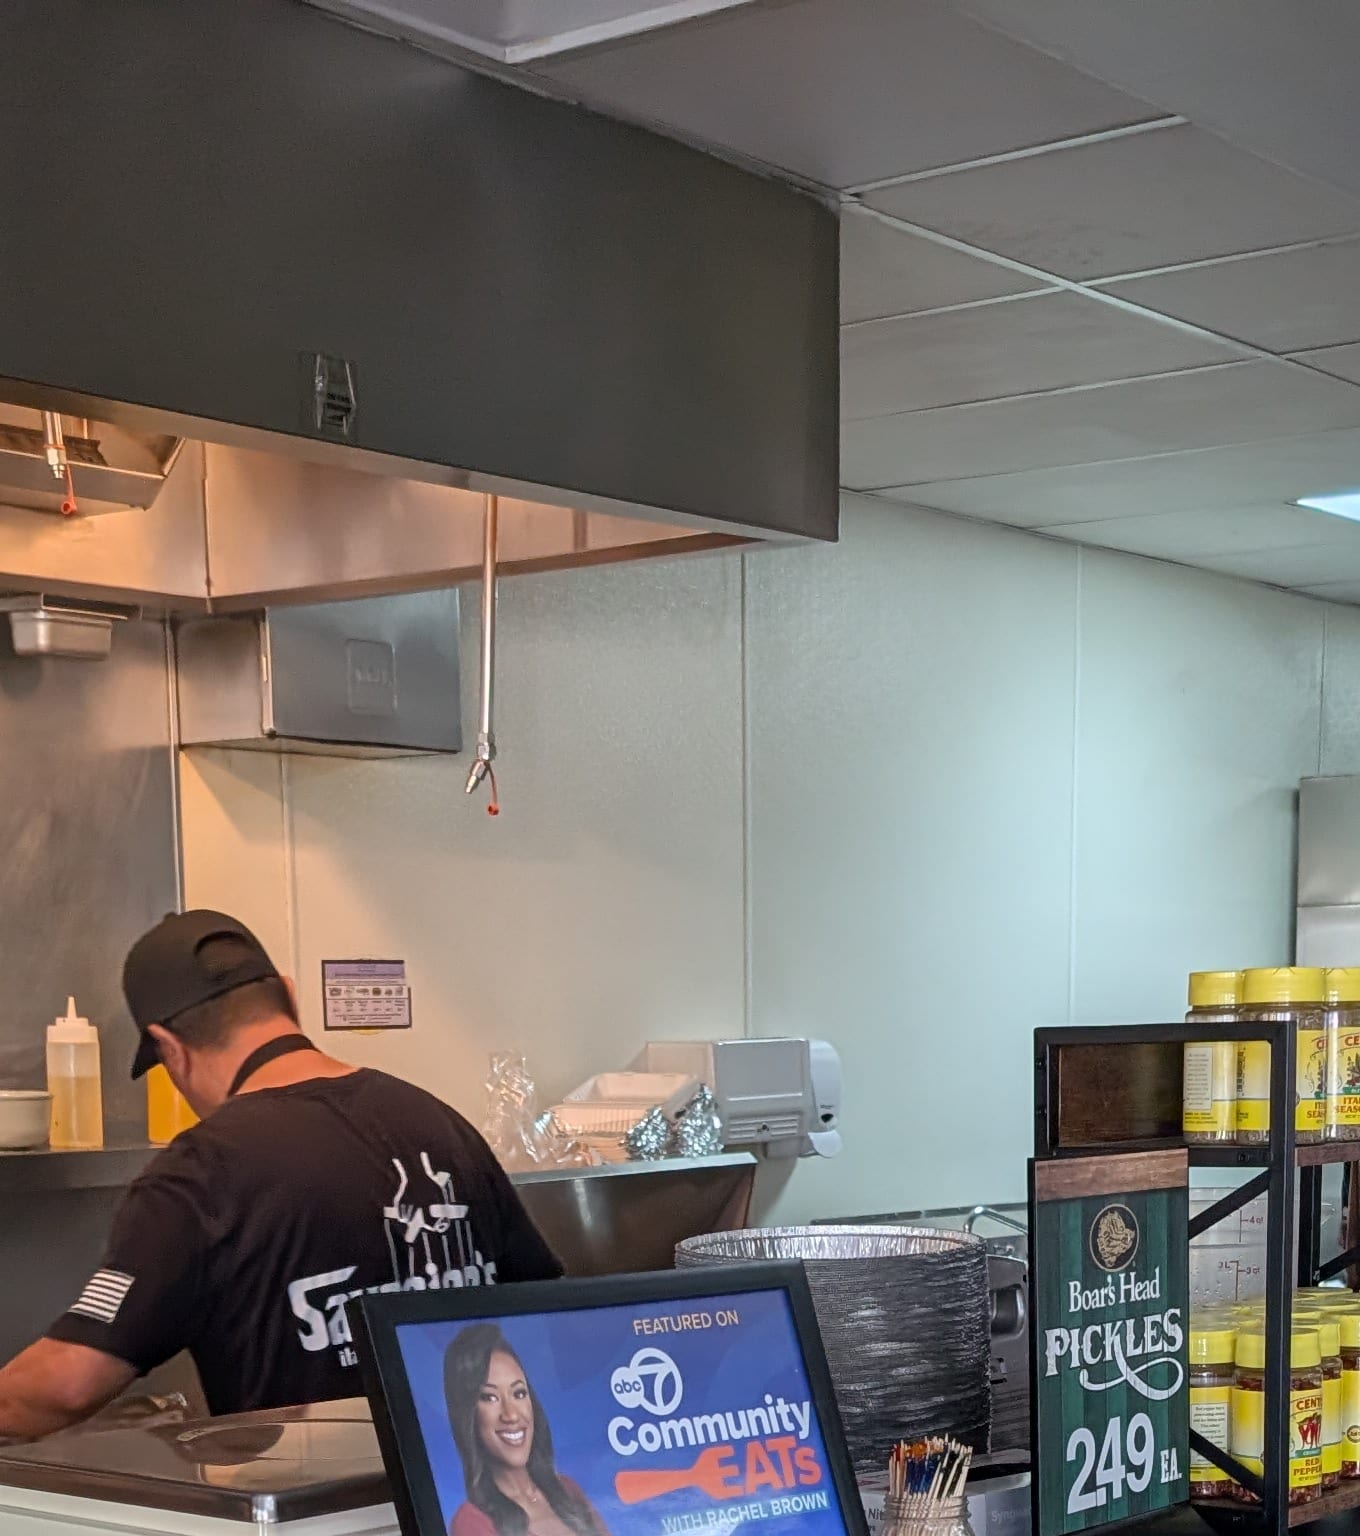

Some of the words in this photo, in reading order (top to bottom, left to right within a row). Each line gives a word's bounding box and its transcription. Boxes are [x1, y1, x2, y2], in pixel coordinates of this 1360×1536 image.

[1068, 1276, 1115, 1314] Boar's
[1118, 1267, 1161, 1302] Head
[633, 1313, 711, 1336] FEATURED
[716, 1310, 739, 1329] ON
[1044, 1309, 1184, 1400] PICKLES
[614, 1377, 641, 1394] abc
[1296, 1398, 1322, 1411] CENT
[608, 1394, 810, 1456] Community
[1160, 1447, 1183, 1484] EA.
[1293, 1466, 1322, 1476] PEPPE
[661, 1512, 703, 1535] WITH
[706, 1503, 767, 1530] RACHEL
[770, 1491, 829, 1521] BROWN
